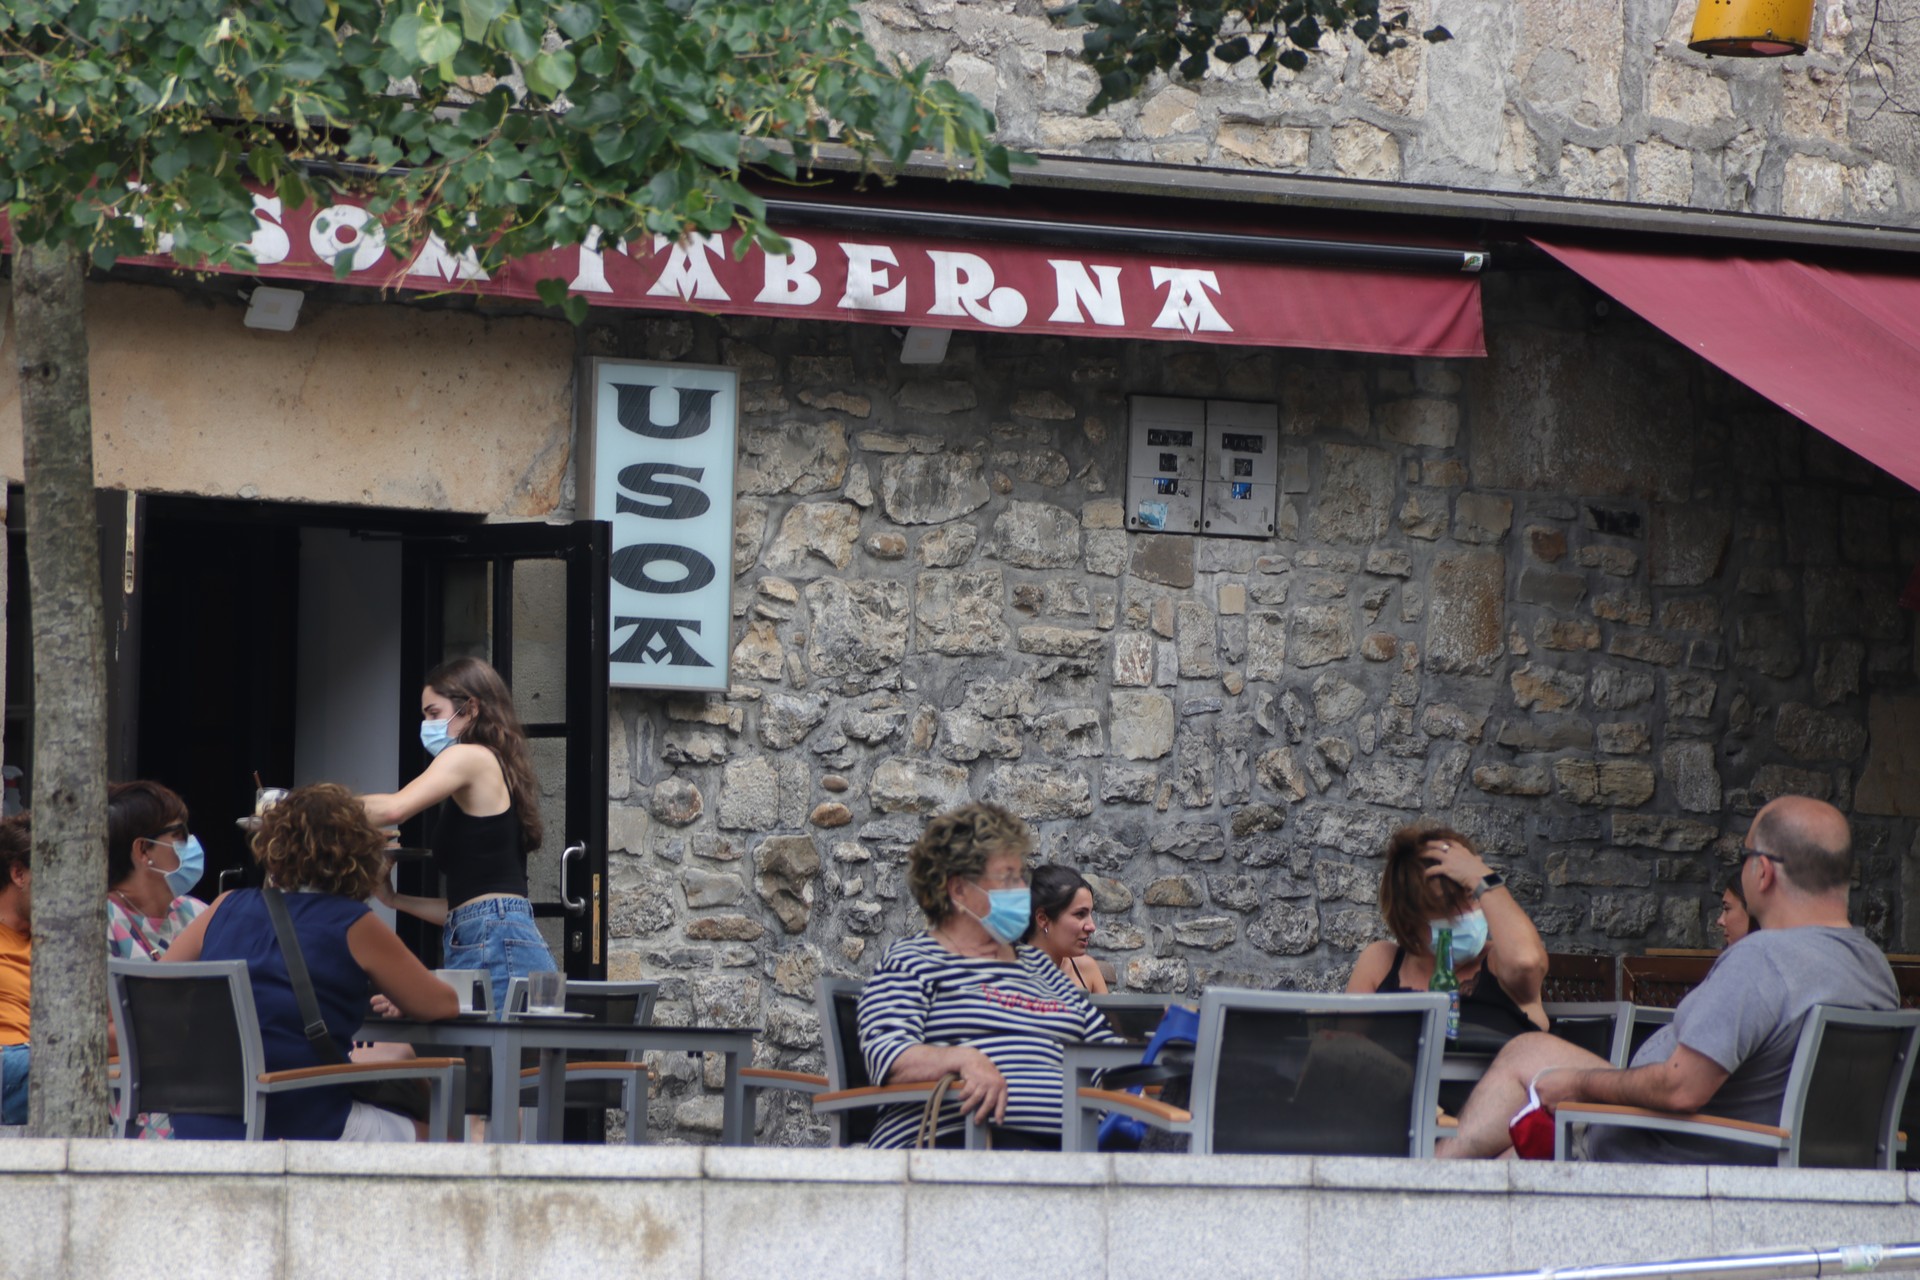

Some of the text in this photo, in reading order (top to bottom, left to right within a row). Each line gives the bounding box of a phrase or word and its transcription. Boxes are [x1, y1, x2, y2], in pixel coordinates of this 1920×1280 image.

[113, 181, 1234, 334] SOA TABERNA
[606, 382, 723, 668] USOA
